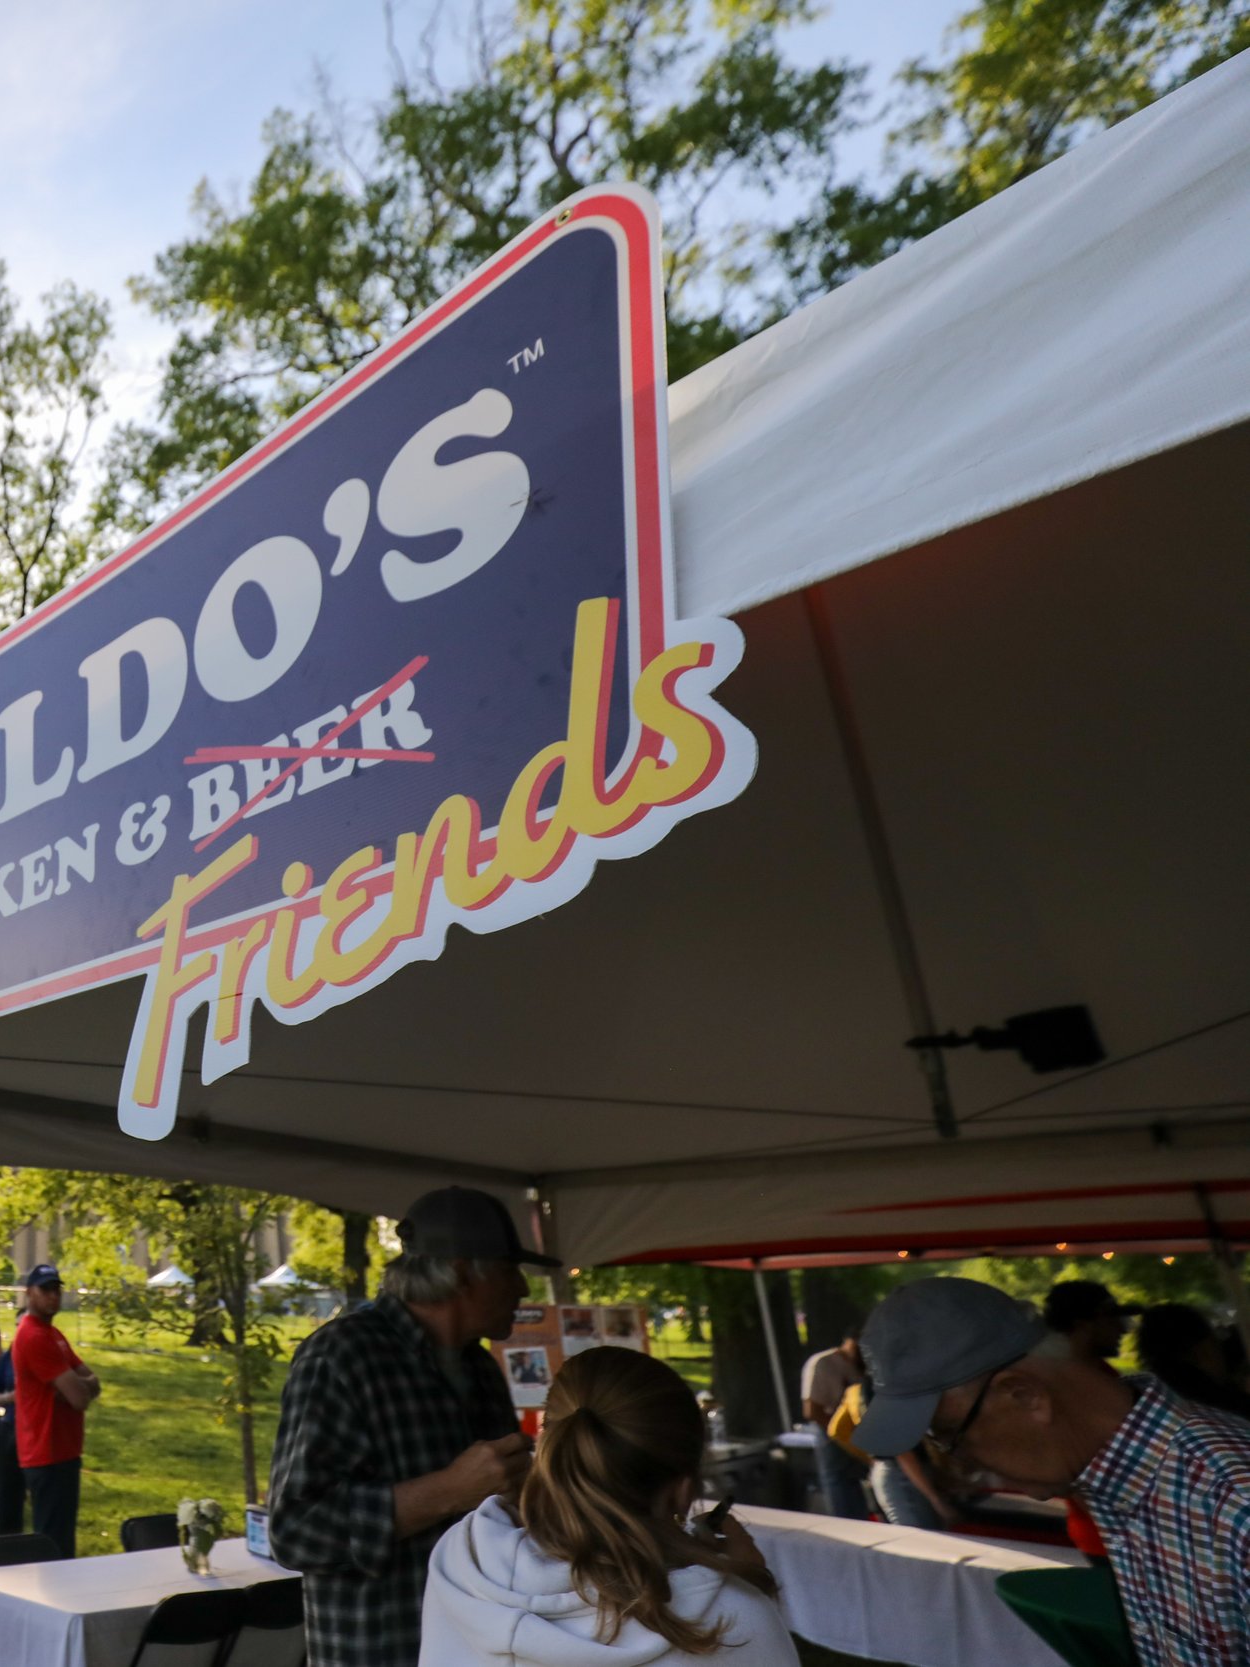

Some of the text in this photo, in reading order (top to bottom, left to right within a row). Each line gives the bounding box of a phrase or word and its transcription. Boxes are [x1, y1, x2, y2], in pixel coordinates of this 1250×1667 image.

[506, 338, 546, 375] TM
[116, 795, 171, 866] &
[188, 678, 433, 842] BEER
[131, 597, 725, 1109] Friends
